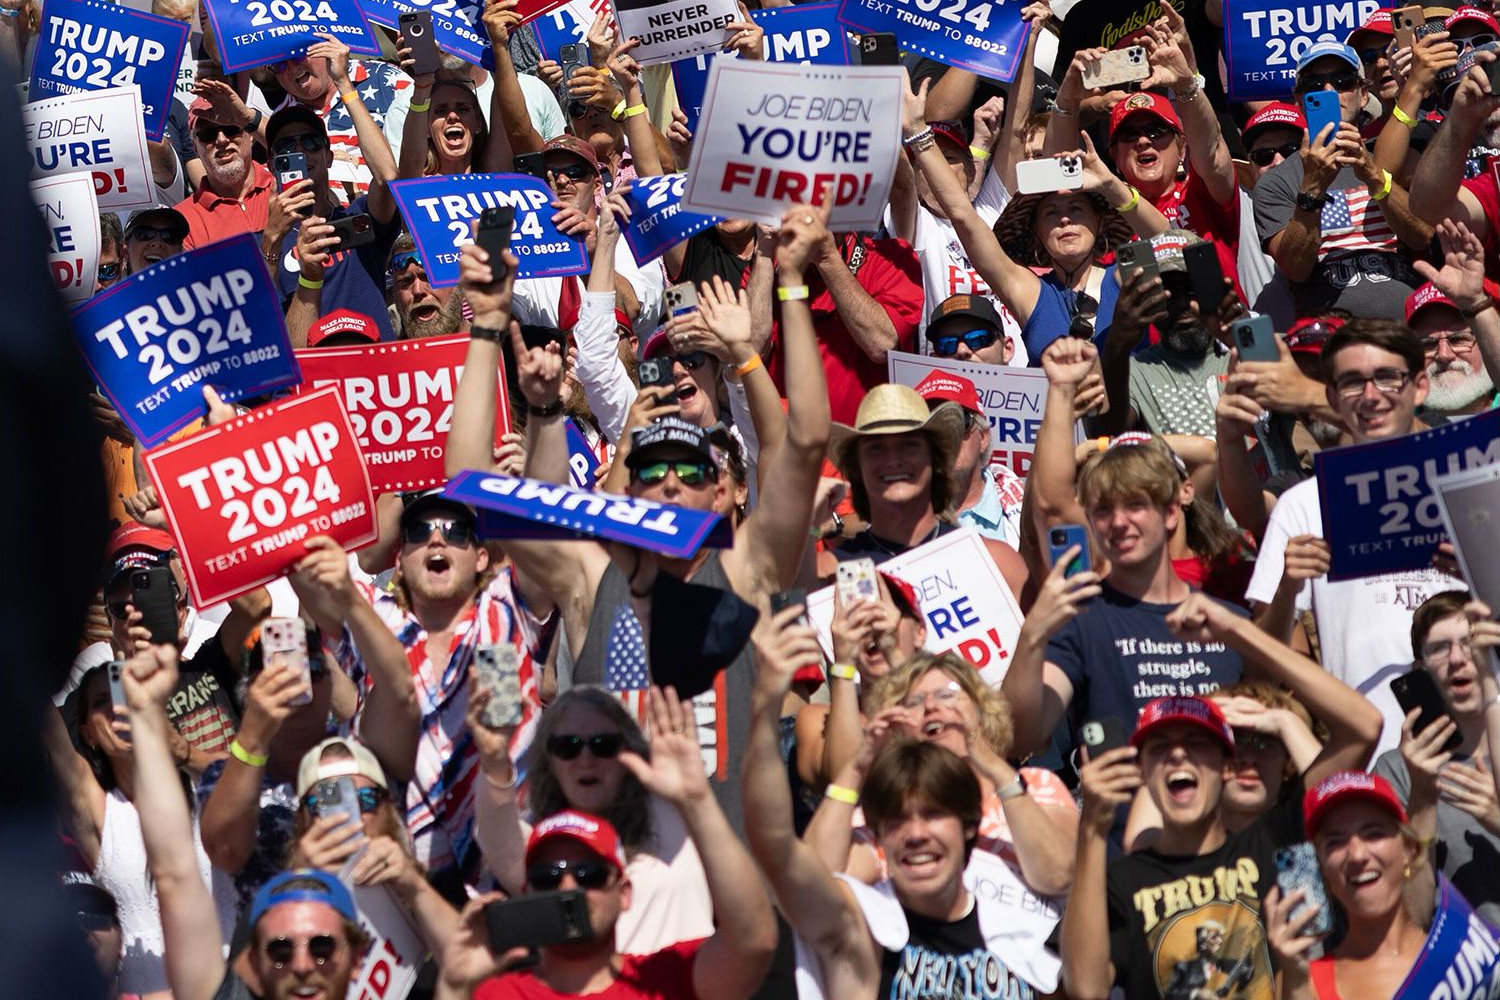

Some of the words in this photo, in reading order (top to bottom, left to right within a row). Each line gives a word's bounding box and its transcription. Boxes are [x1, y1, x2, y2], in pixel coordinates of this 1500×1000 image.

[437, 18, 453, 30] TO
[647, 3, 709, 28] NEVER
[1243, 0, 1380, 38] TRUMP
[50, 16, 165, 67] TRUMP
[233, 30, 265, 47] TEXT
[269, 24, 309, 38] TRUMP
[311, 23, 327, 34] TO
[329, 24, 364, 35] 88022
[896, 8, 941, 33] TRUMP
[944, 25, 962, 41] TO
[963, 34, 1008, 57] 88022
[51, 48, 137, 89] 2024
[1244, 70, 1278, 82] TEXT
[37, 77, 55, 91] TEXT
[746, 94, 803, 120] JOE
[806, 97, 873, 123] BIDEN,
[1269, 109, 1299, 118] AMERICA
[38, 114, 105, 141] BIDEN,
[737, 123, 871, 163] YOU'RE
[720, 162, 873, 207] FIRED!
[416, 189, 549, 222] TRUMP
[637, 213, 660, 235] TEXT
[516, 245, 531, 256] TO
[533, 242, 570, 255] 88022
[95, 268, 254, 360] TRUMP
[337, 317, 367, 327] AMERICA
[344, 323, 364, 332] AGAIN
[137, 309, 252, 385] 2024
[136, 387, 172, 415] TEXT
[170, 361, 222, 393] TRUMP
[223, 356, 241, 370] TO
[243, 345, 280, 366] 88022
[669, 430, 701, 447] AGAIN
[177, 420, 340, 511] TRUMP
[420, 447, 443, 460] TO
[219, 465, 341, 544] 2024
[479, 478, 679, 536] TRUMP
[204, 550, 248, 576] TEXT
[251, 524, 309, 557] TRUMP
[310, 515, 330, 531] TO
[330, 502, 366, 526] 88022
[1349, 540, 1394, 556] TEXT
[1139, 639, 1183, 655] there
[1138, 660, 1210, 680] struggle,
[1133, 681, 1176, 698] there
[1180, 682, 1193, 696] is
[1198, 684, 1220, 697] no
[1134, 857, 1260, 934] TRUMP
